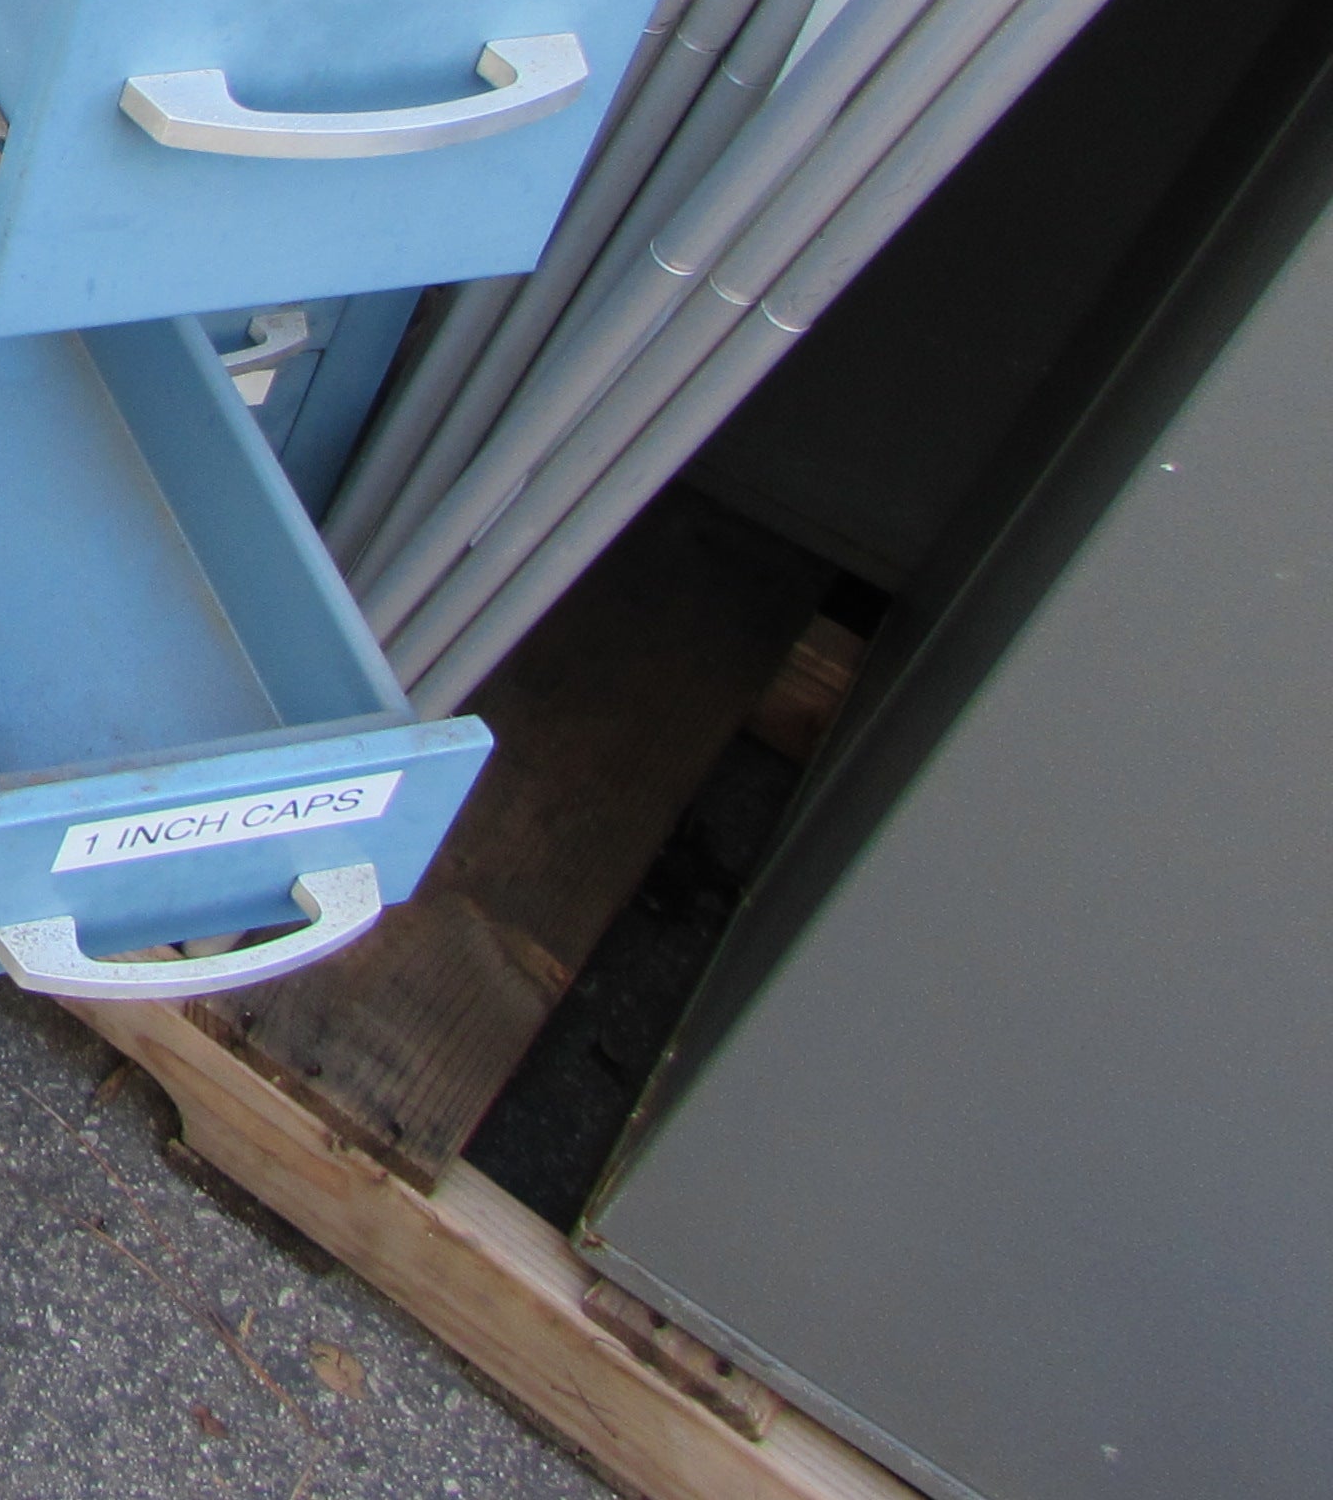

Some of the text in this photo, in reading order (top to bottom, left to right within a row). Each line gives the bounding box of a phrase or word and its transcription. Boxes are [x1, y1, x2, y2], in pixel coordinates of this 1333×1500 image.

[85, 788, 364, 855] 1 INCH CAPS
